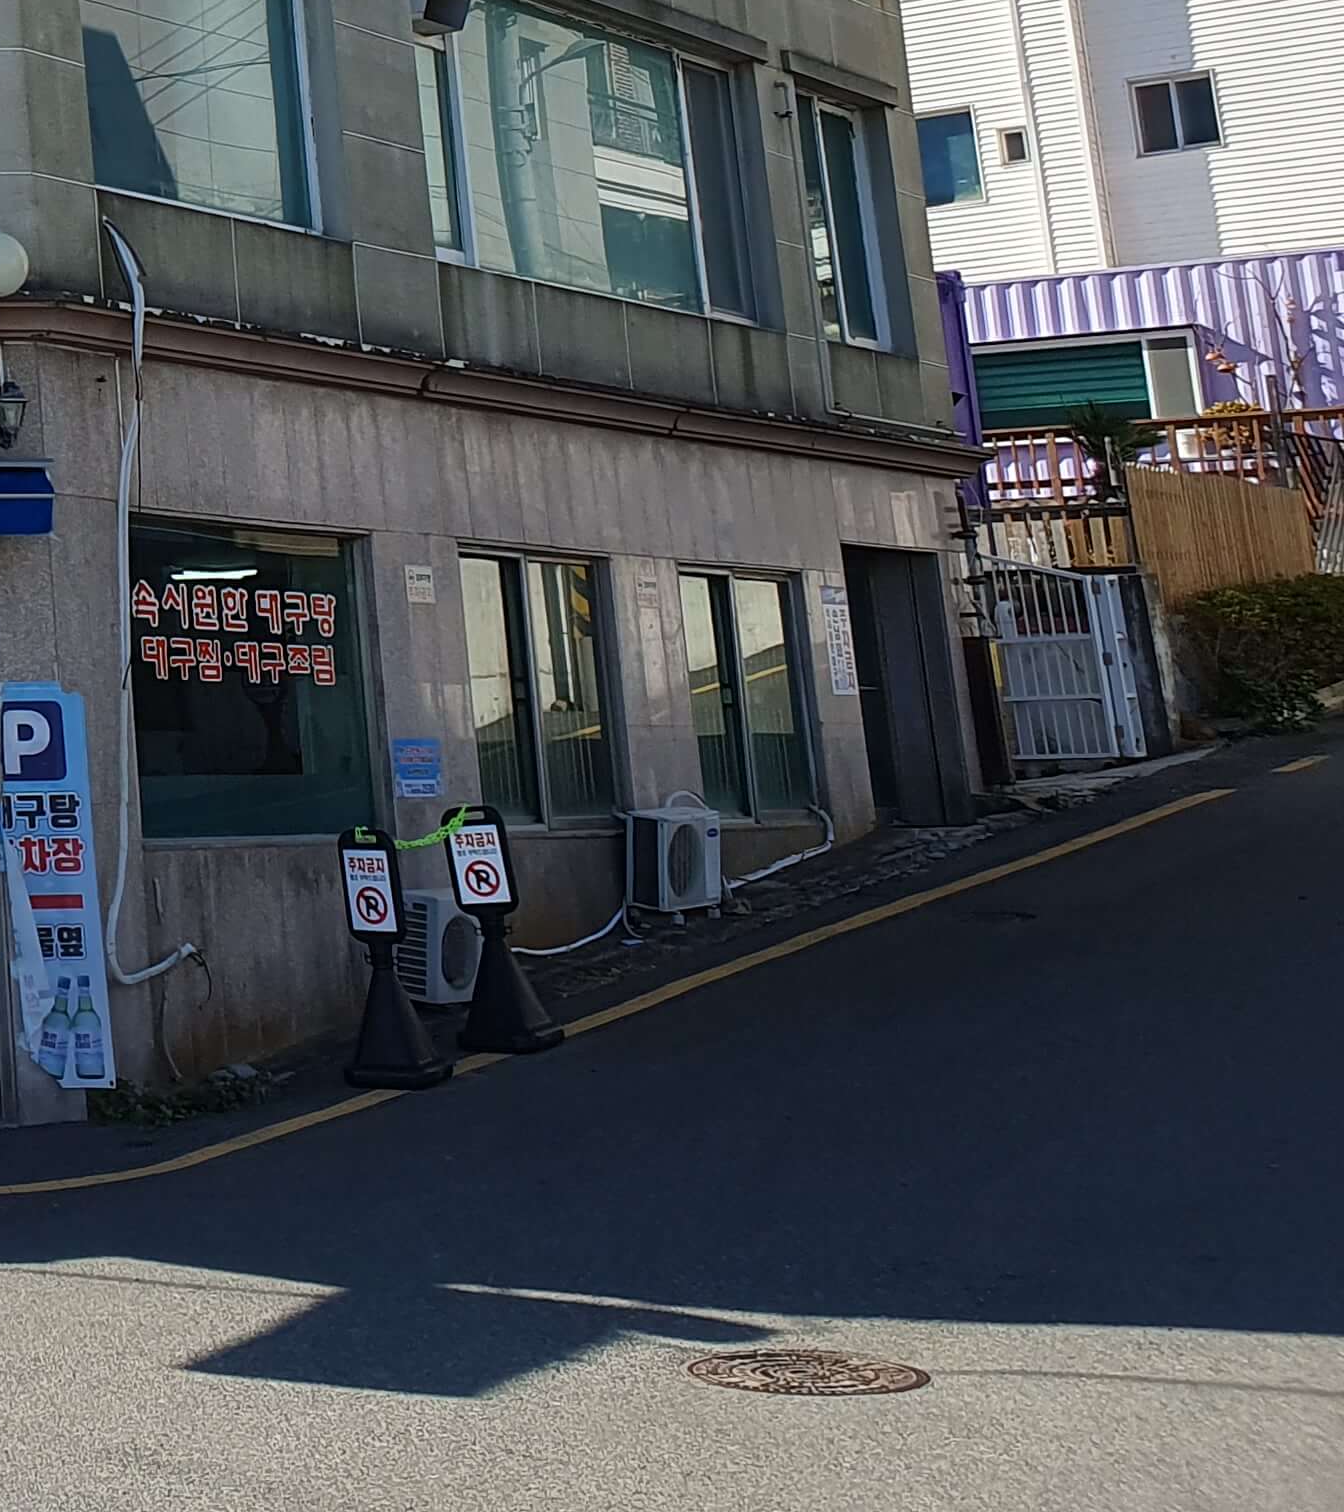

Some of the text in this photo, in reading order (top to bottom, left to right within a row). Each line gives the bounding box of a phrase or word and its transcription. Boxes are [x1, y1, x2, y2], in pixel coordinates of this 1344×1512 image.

[131, 579, 337, 638] 속시원한 대구탕
[2, 709, 50, 775] P
[9, 837, 83, 873] 차장
